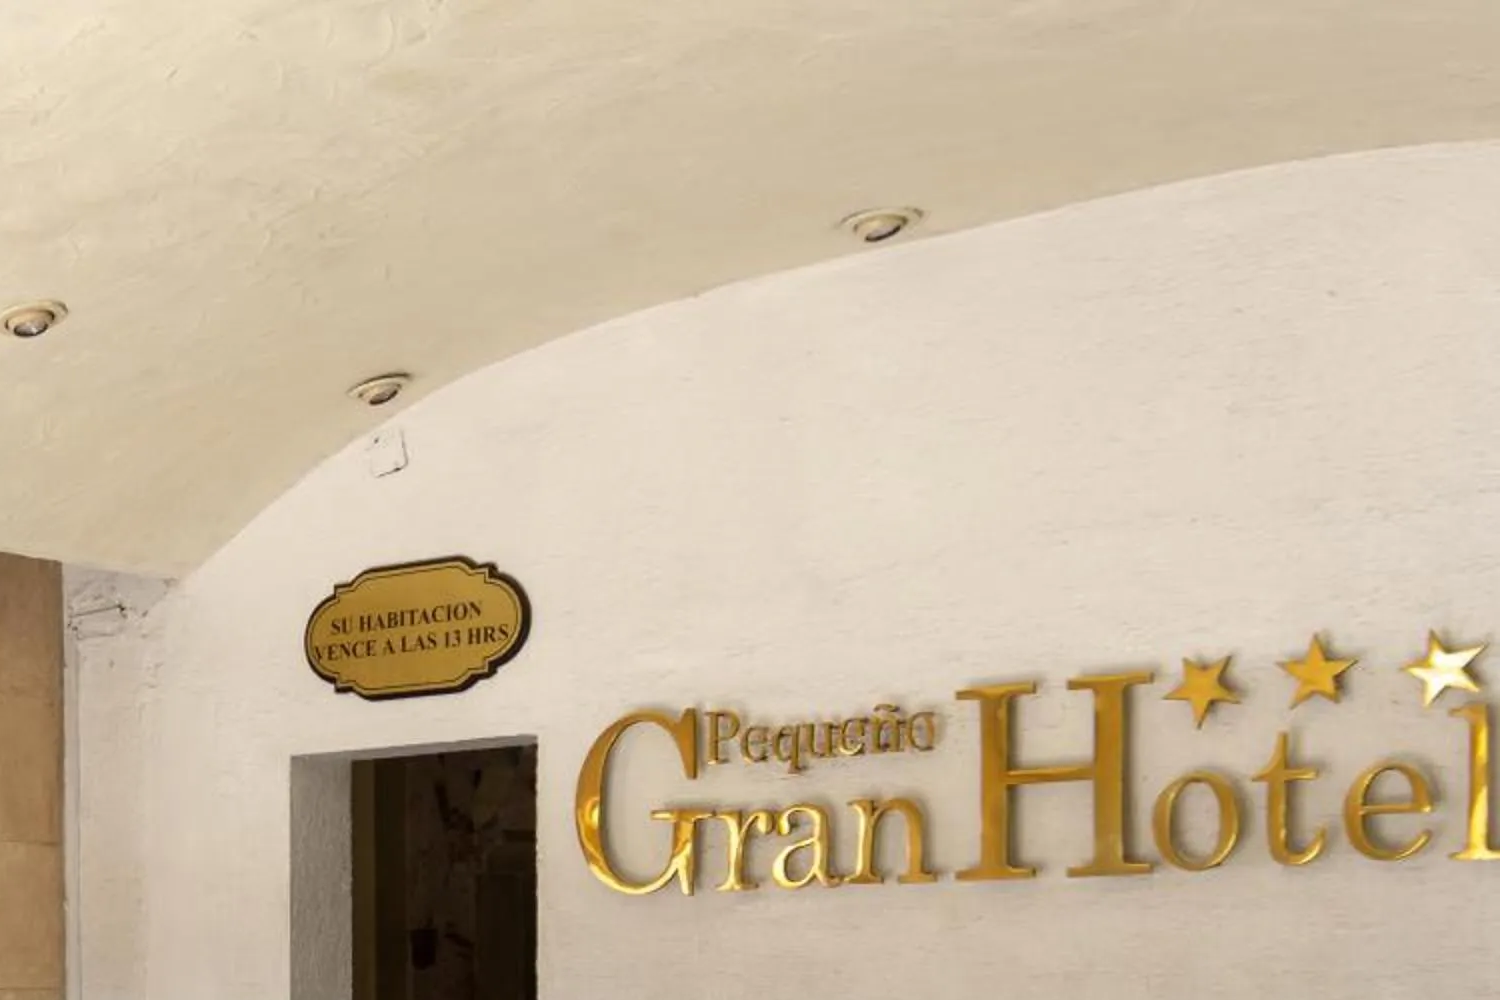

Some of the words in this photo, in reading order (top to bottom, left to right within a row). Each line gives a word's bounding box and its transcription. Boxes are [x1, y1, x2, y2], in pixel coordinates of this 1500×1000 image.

[314, 639, 377, 662] VENCE
[383, 637, 397, 655] A
[402, 632, 437, 653] LAS
[444, 629, 462, 649] 13
[468, 623, 510, 645] HRS
[331, 617, 353, 636] SU
[359, 600, 483, 633] HABITACION
[704, 703, 935, 774] Pequeño
[575, 707, 937, 896] Gran
[955, 671, 1500, 878] Hotel
